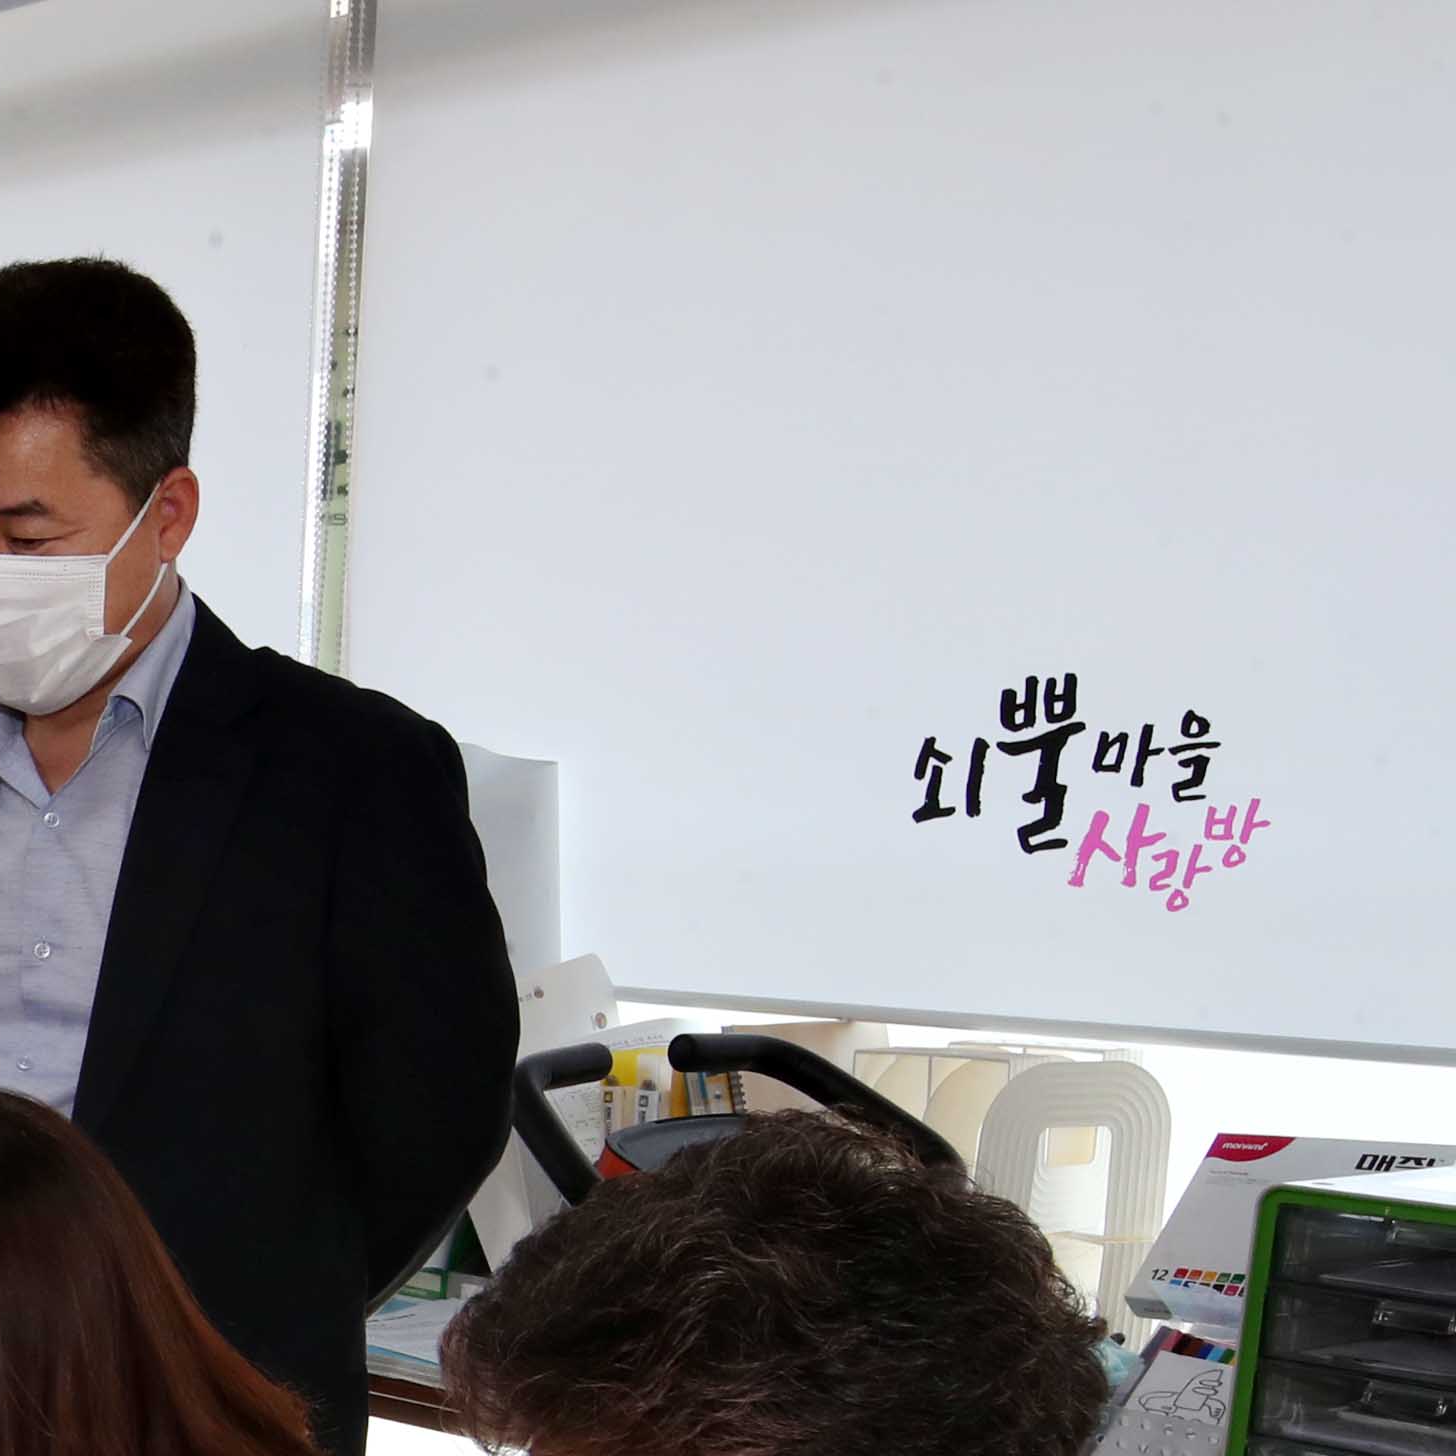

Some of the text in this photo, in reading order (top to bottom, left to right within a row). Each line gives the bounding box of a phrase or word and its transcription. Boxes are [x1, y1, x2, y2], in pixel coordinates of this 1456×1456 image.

[912, 673, 1221, 854] 쇠뿔마을
[1067, 798, 1271, 912] 사랑방
[1151, 1269, 1169, 1281] 12
